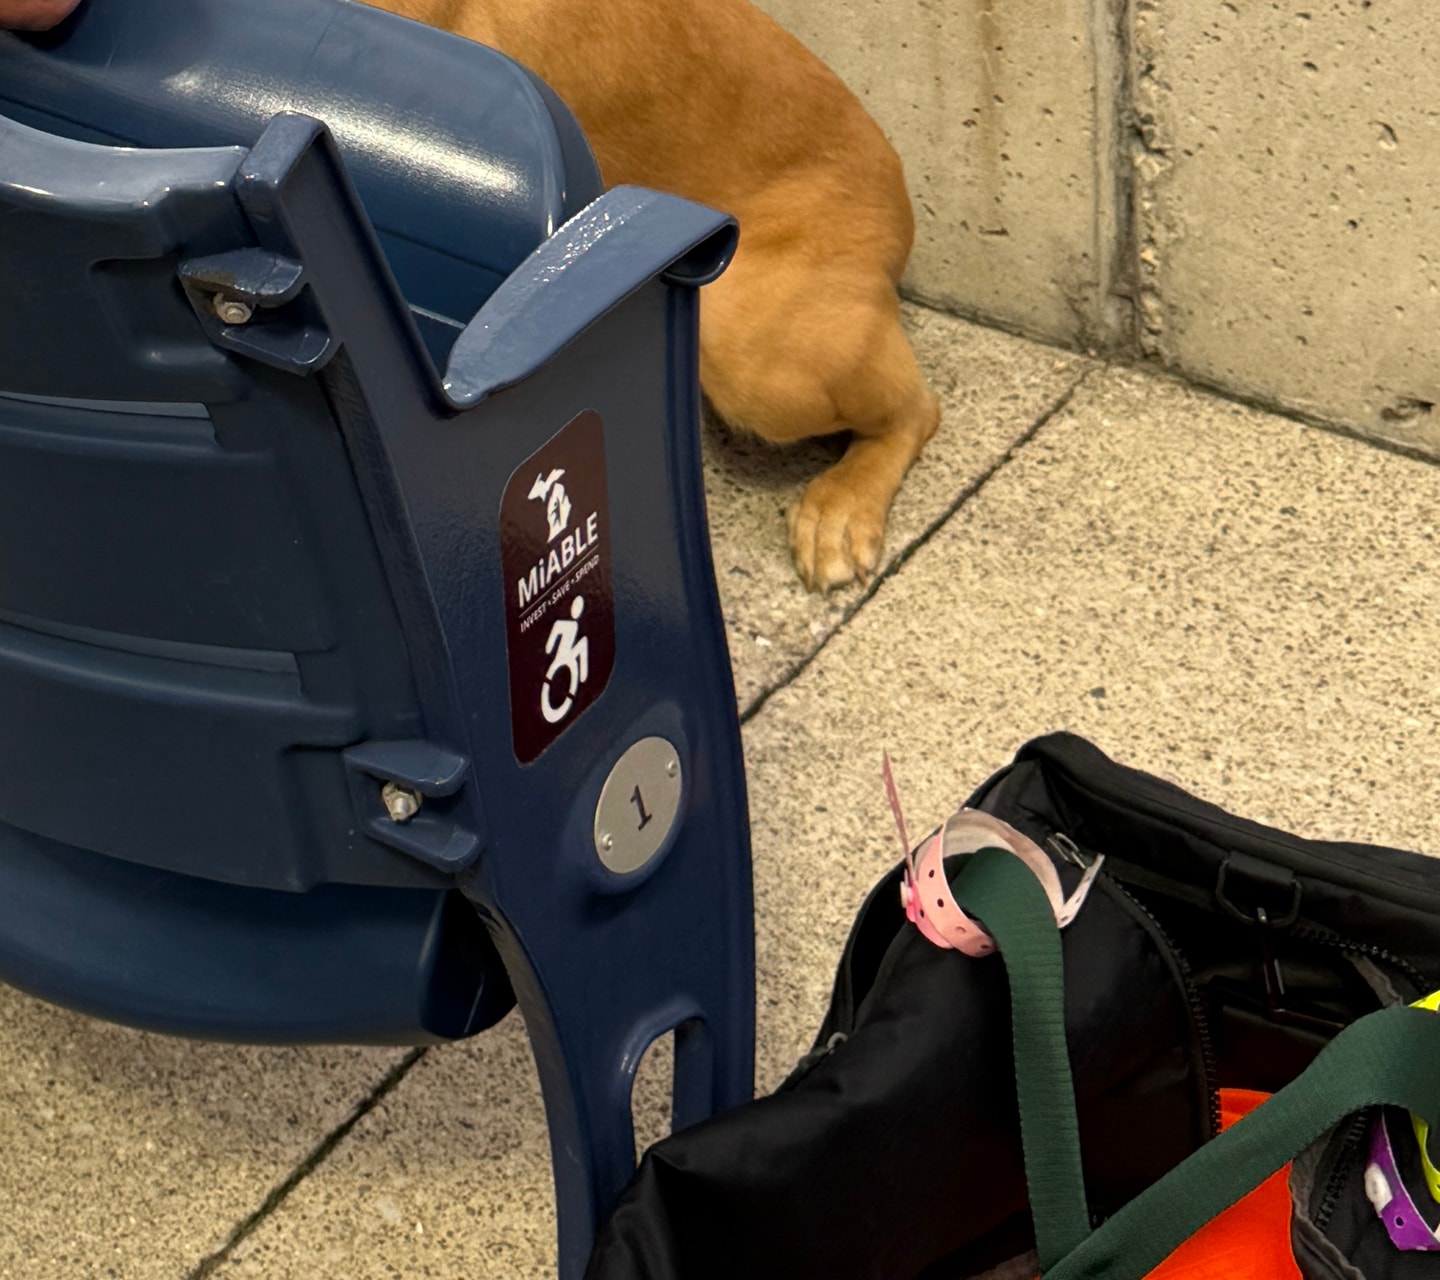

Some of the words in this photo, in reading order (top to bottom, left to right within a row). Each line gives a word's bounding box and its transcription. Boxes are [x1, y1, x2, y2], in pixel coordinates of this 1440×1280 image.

[518, 511, 598, 608] MiABLE
[520, 602, 547, 633] INVEST
[552, 582, 570, 604] SAVE
[575, 554, 600, 583] SPEND
[630, 784, 653, 831] 1
